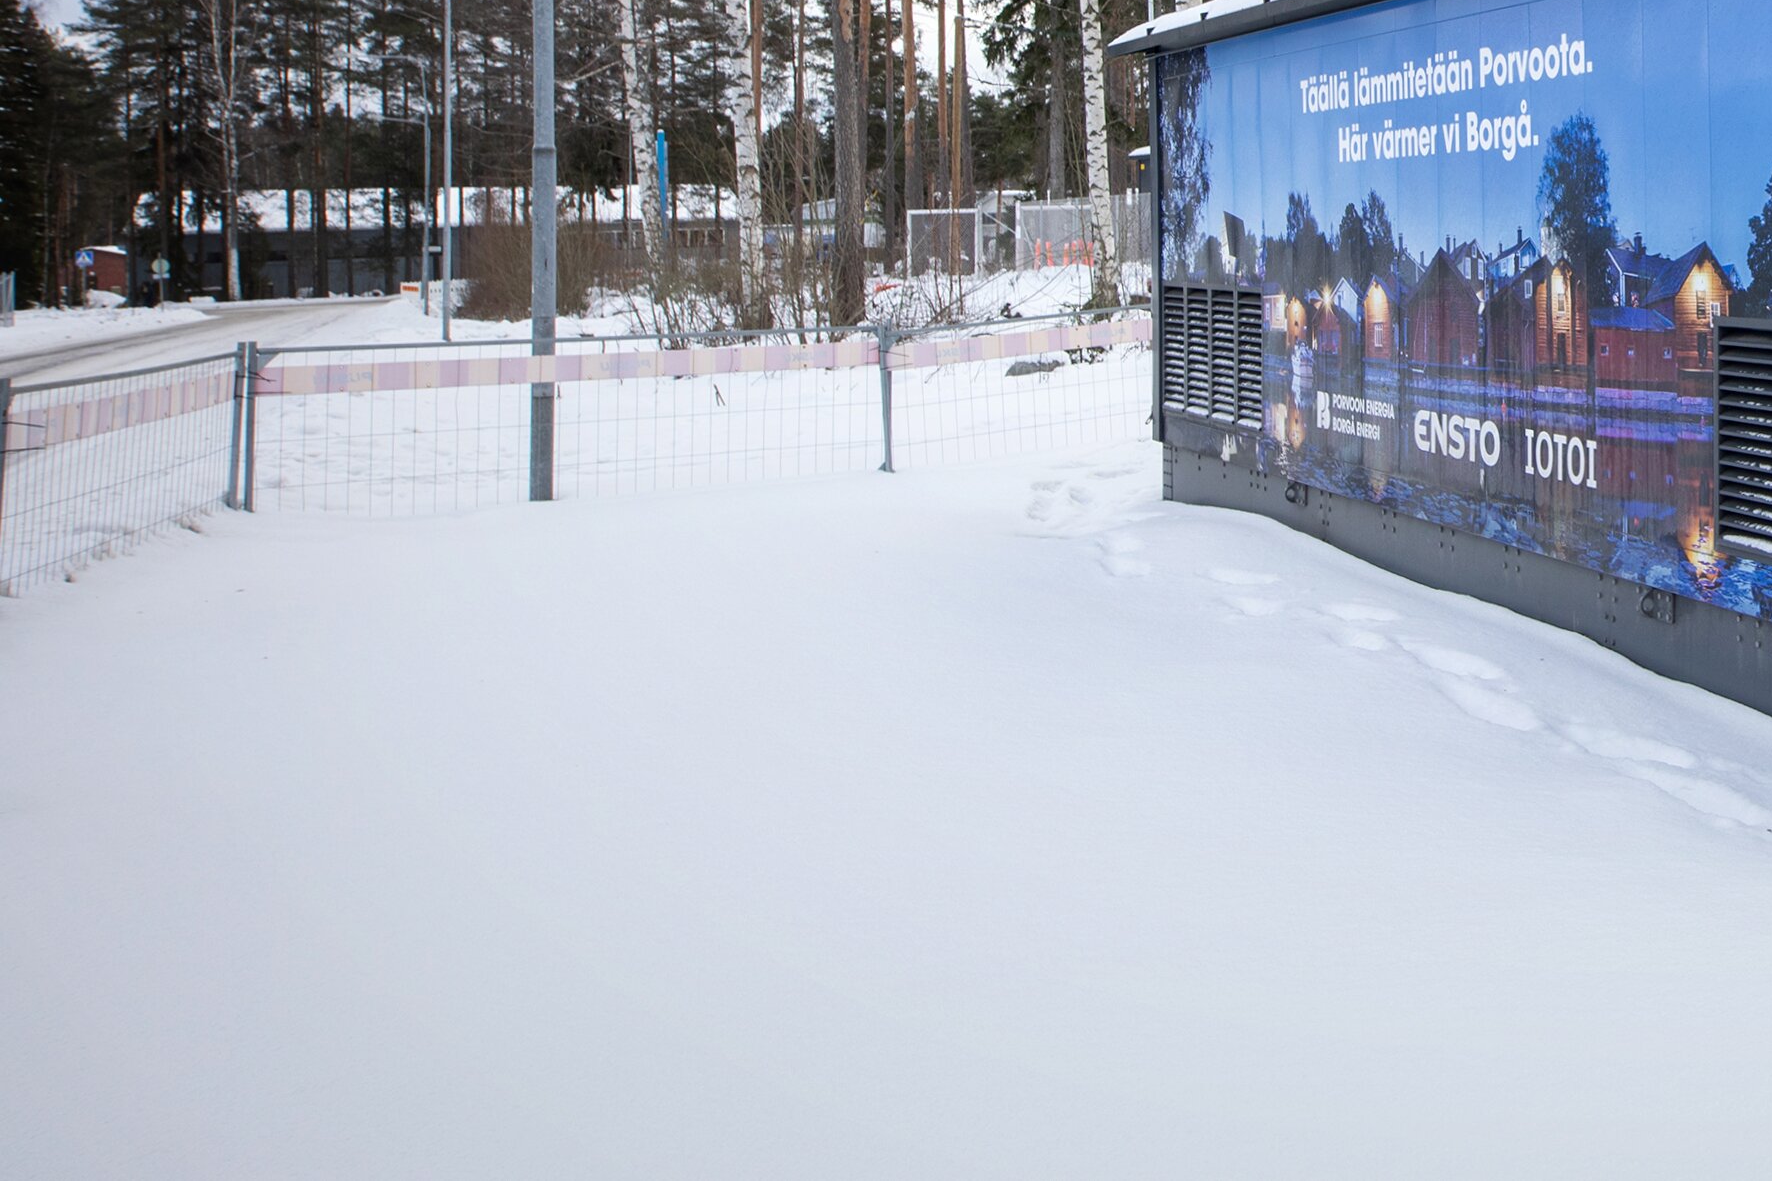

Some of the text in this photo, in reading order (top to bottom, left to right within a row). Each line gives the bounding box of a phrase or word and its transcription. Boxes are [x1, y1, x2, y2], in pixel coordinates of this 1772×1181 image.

[1300, 33, 1593, 114] Täällä lämmitetään Porvoota.
[1338, 99, 1540, 163] Här värmer vi Borgå.
[1332, 393, 1396, 420] PORVOON ENERGIA
[1332, 415, 1381, 442] BORGÅ ENERGI
[1414, 409, 1501, 467] ENSTO
